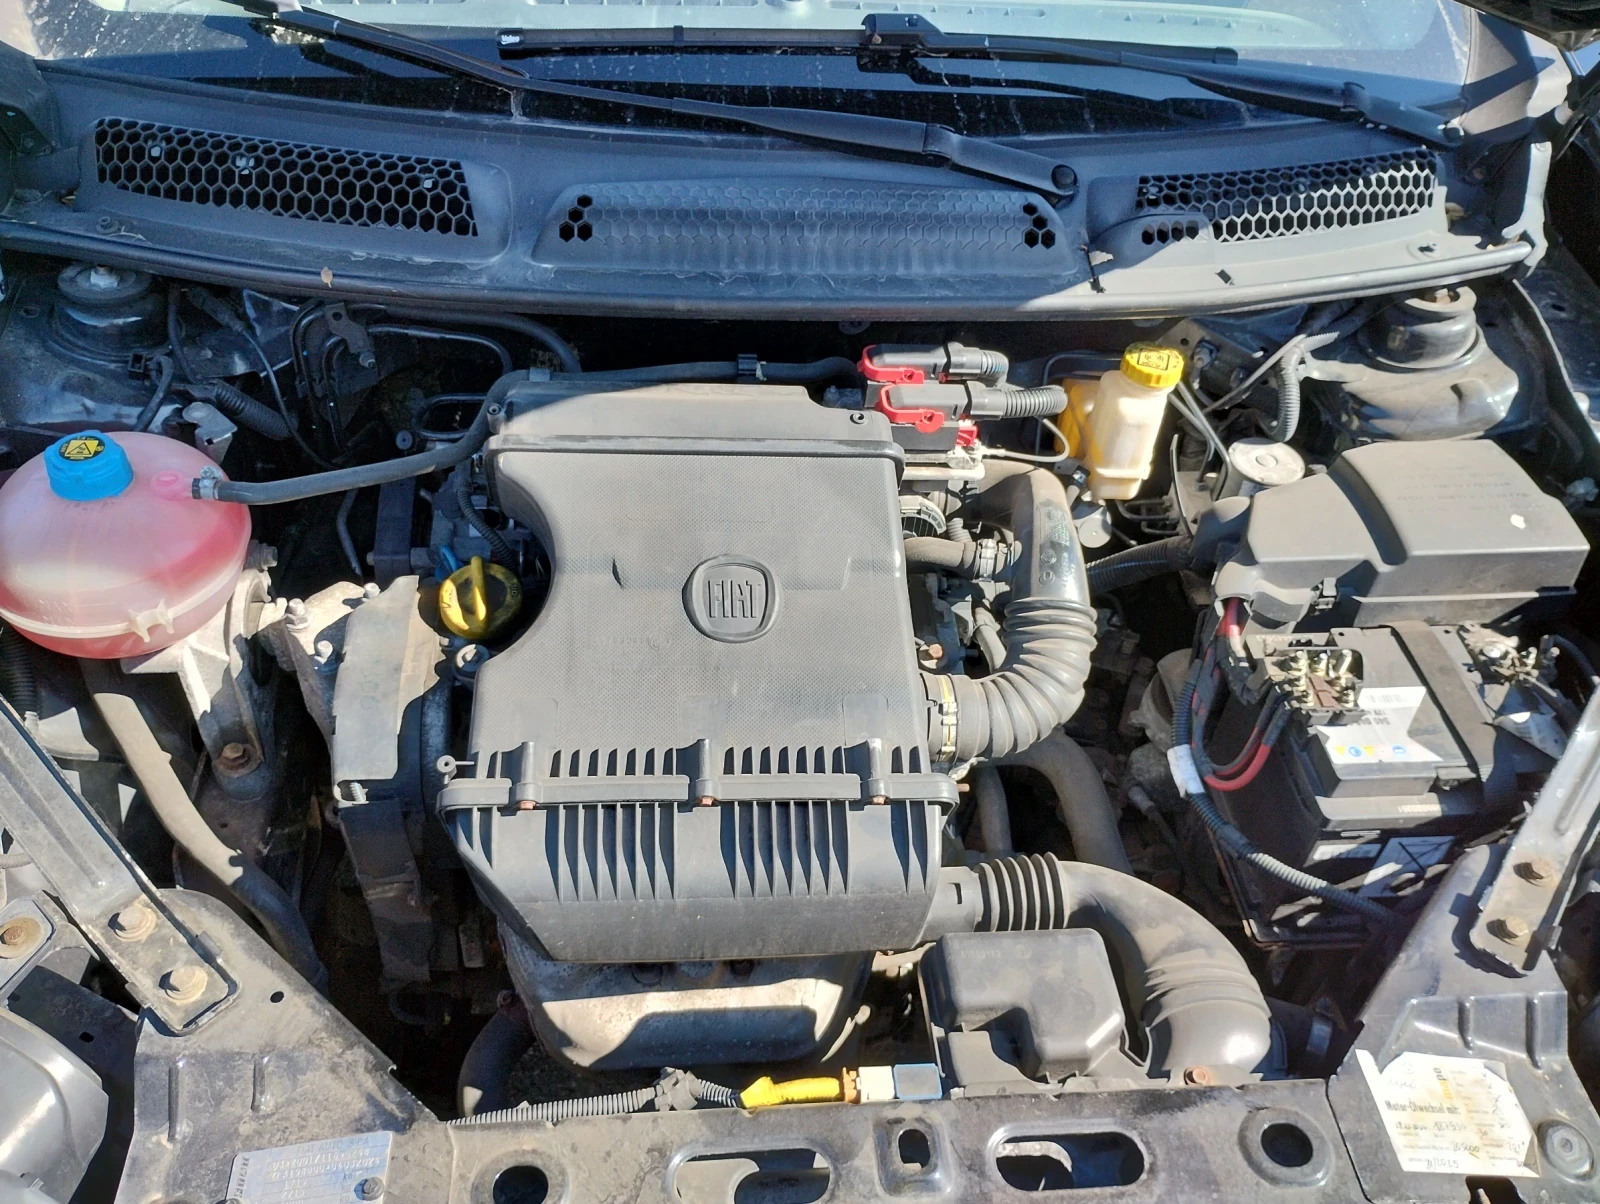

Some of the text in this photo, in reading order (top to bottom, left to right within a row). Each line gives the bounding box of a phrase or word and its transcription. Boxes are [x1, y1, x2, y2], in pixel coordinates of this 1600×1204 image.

[707, 579, 762, 618] FIAT
[1384, 1098, 1446, 1114] Motor-Ölwechsel
[318, 1139, 343, 1150] AUTO
